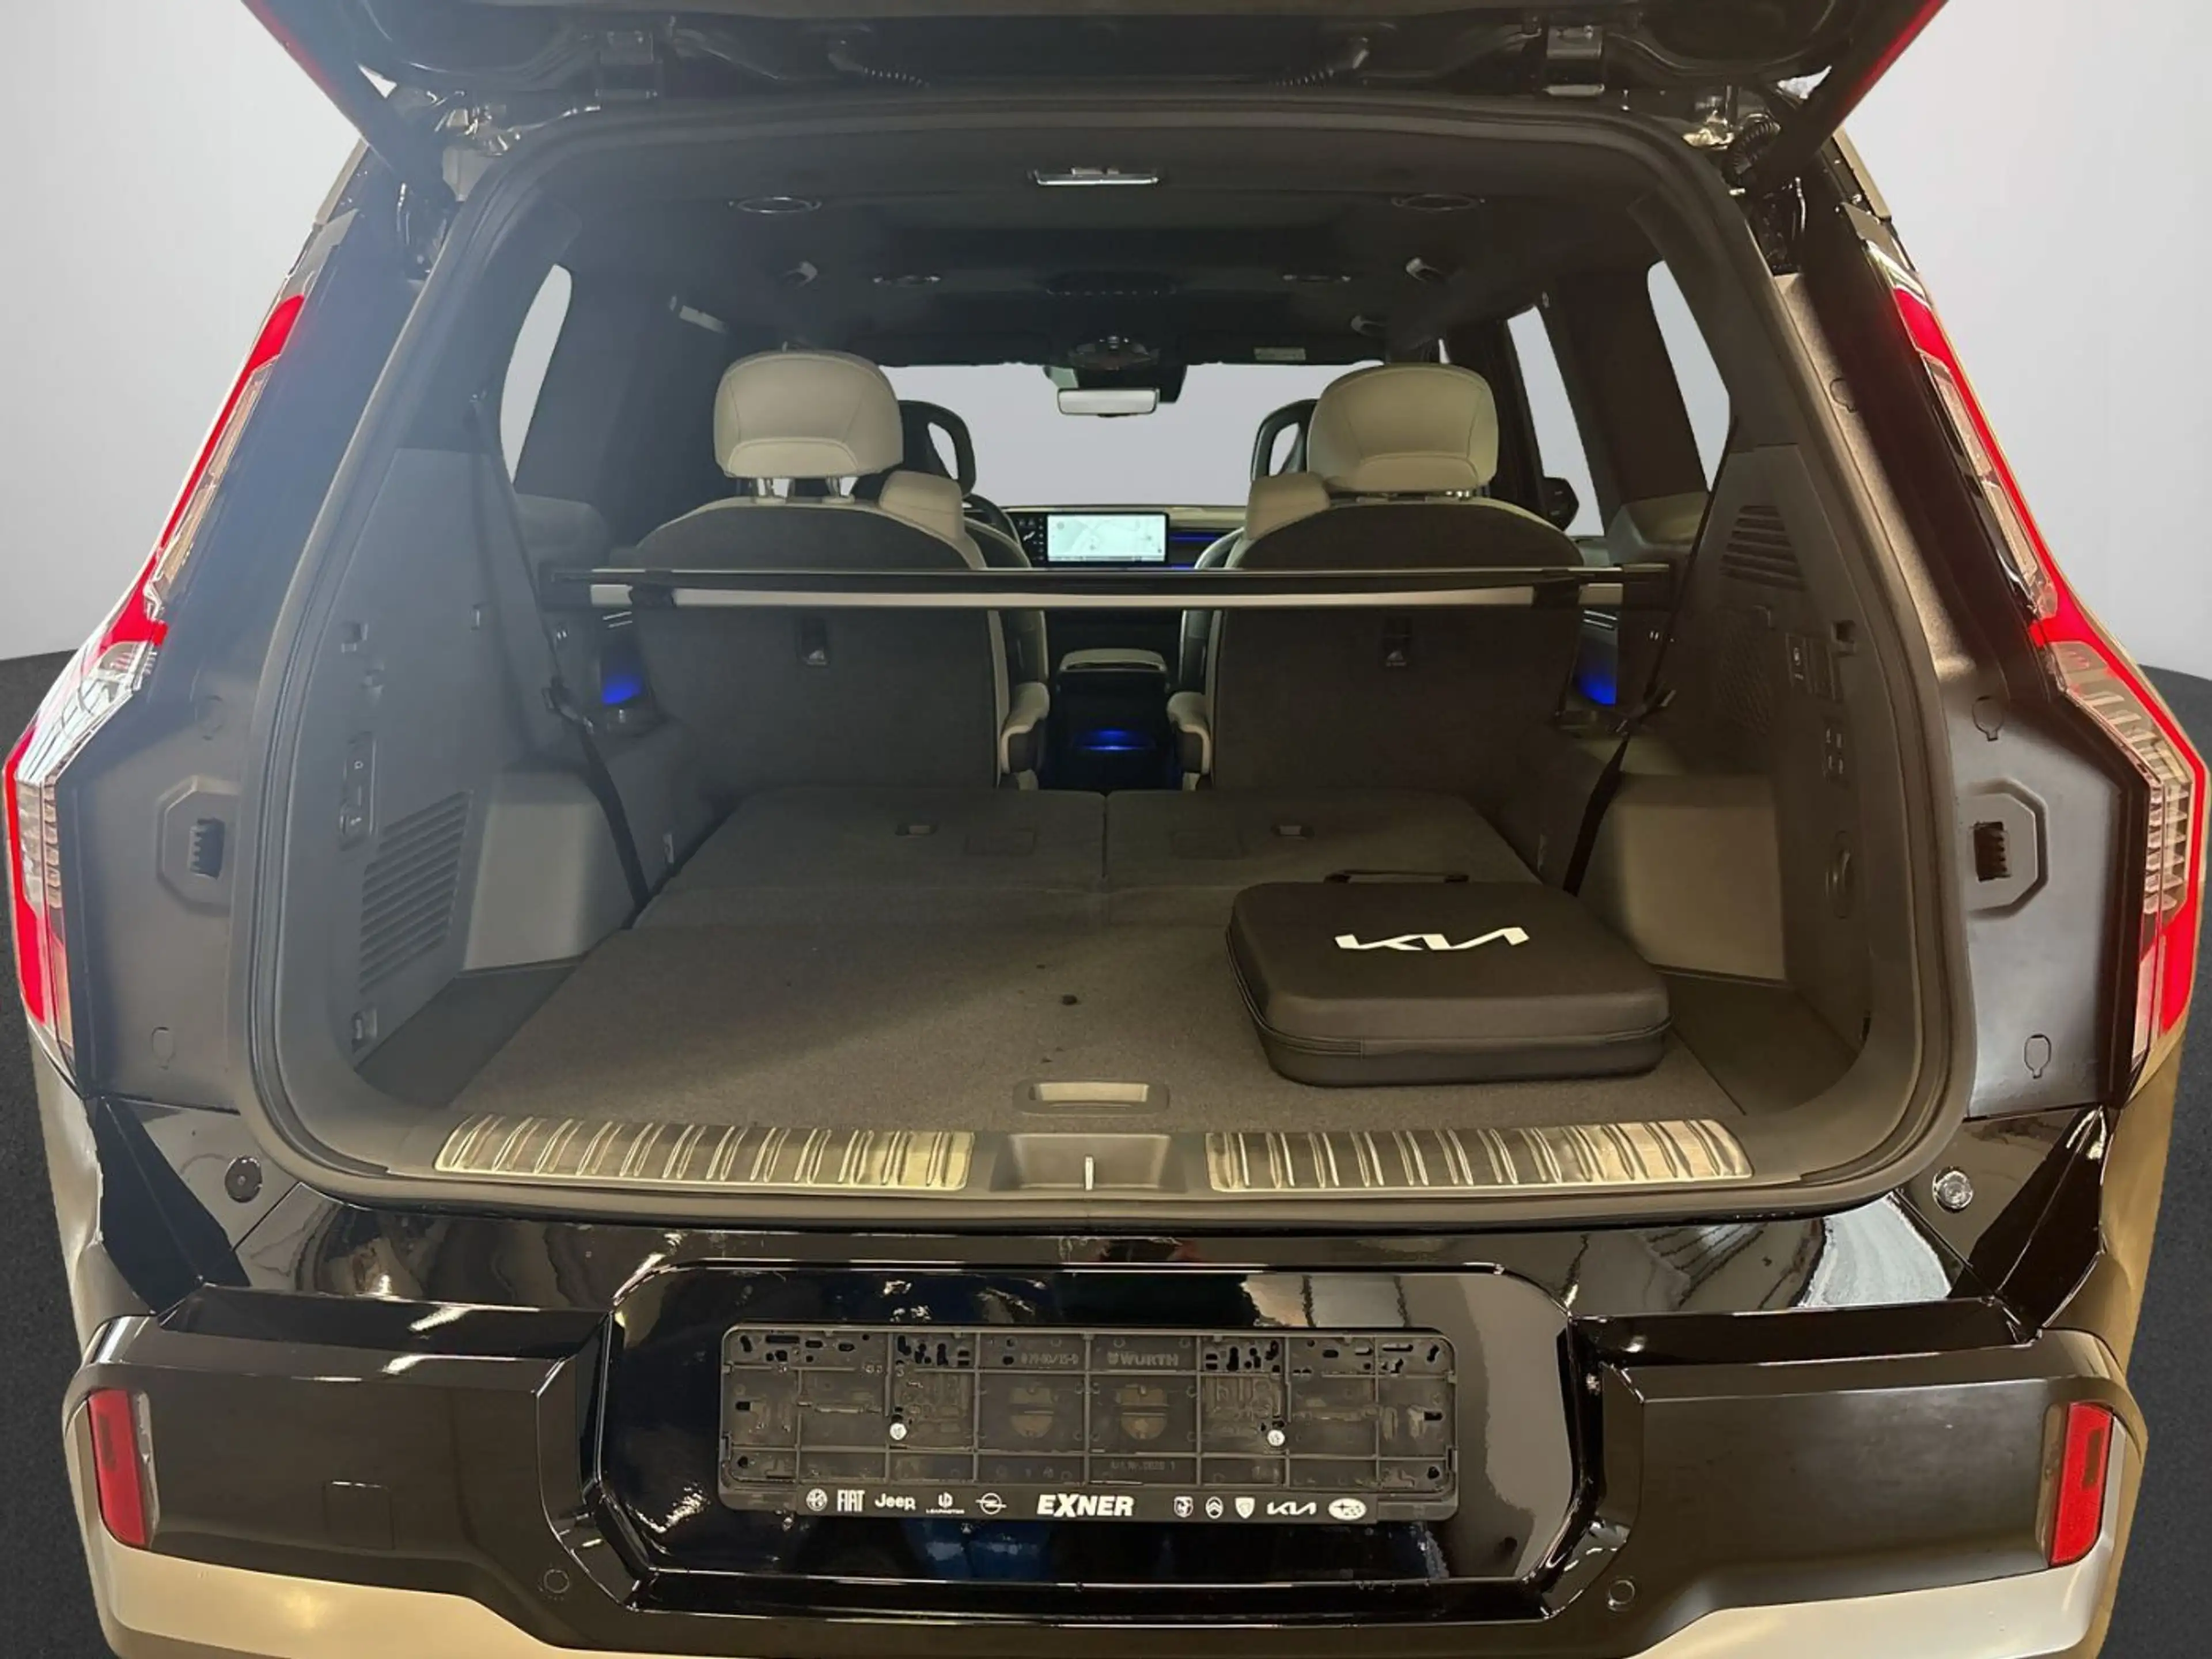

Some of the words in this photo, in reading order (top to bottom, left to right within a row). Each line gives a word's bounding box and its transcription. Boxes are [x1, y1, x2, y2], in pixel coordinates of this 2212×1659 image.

[1335, 927, 1529, 950] KIA
[837, 1489, 865, 1512] FIAT
[875, 1493, 916, 1510] Jeep
[1037, 1493, 1134, 1517] EXNER
[1267, 1501, 1317, 1515] KIA
